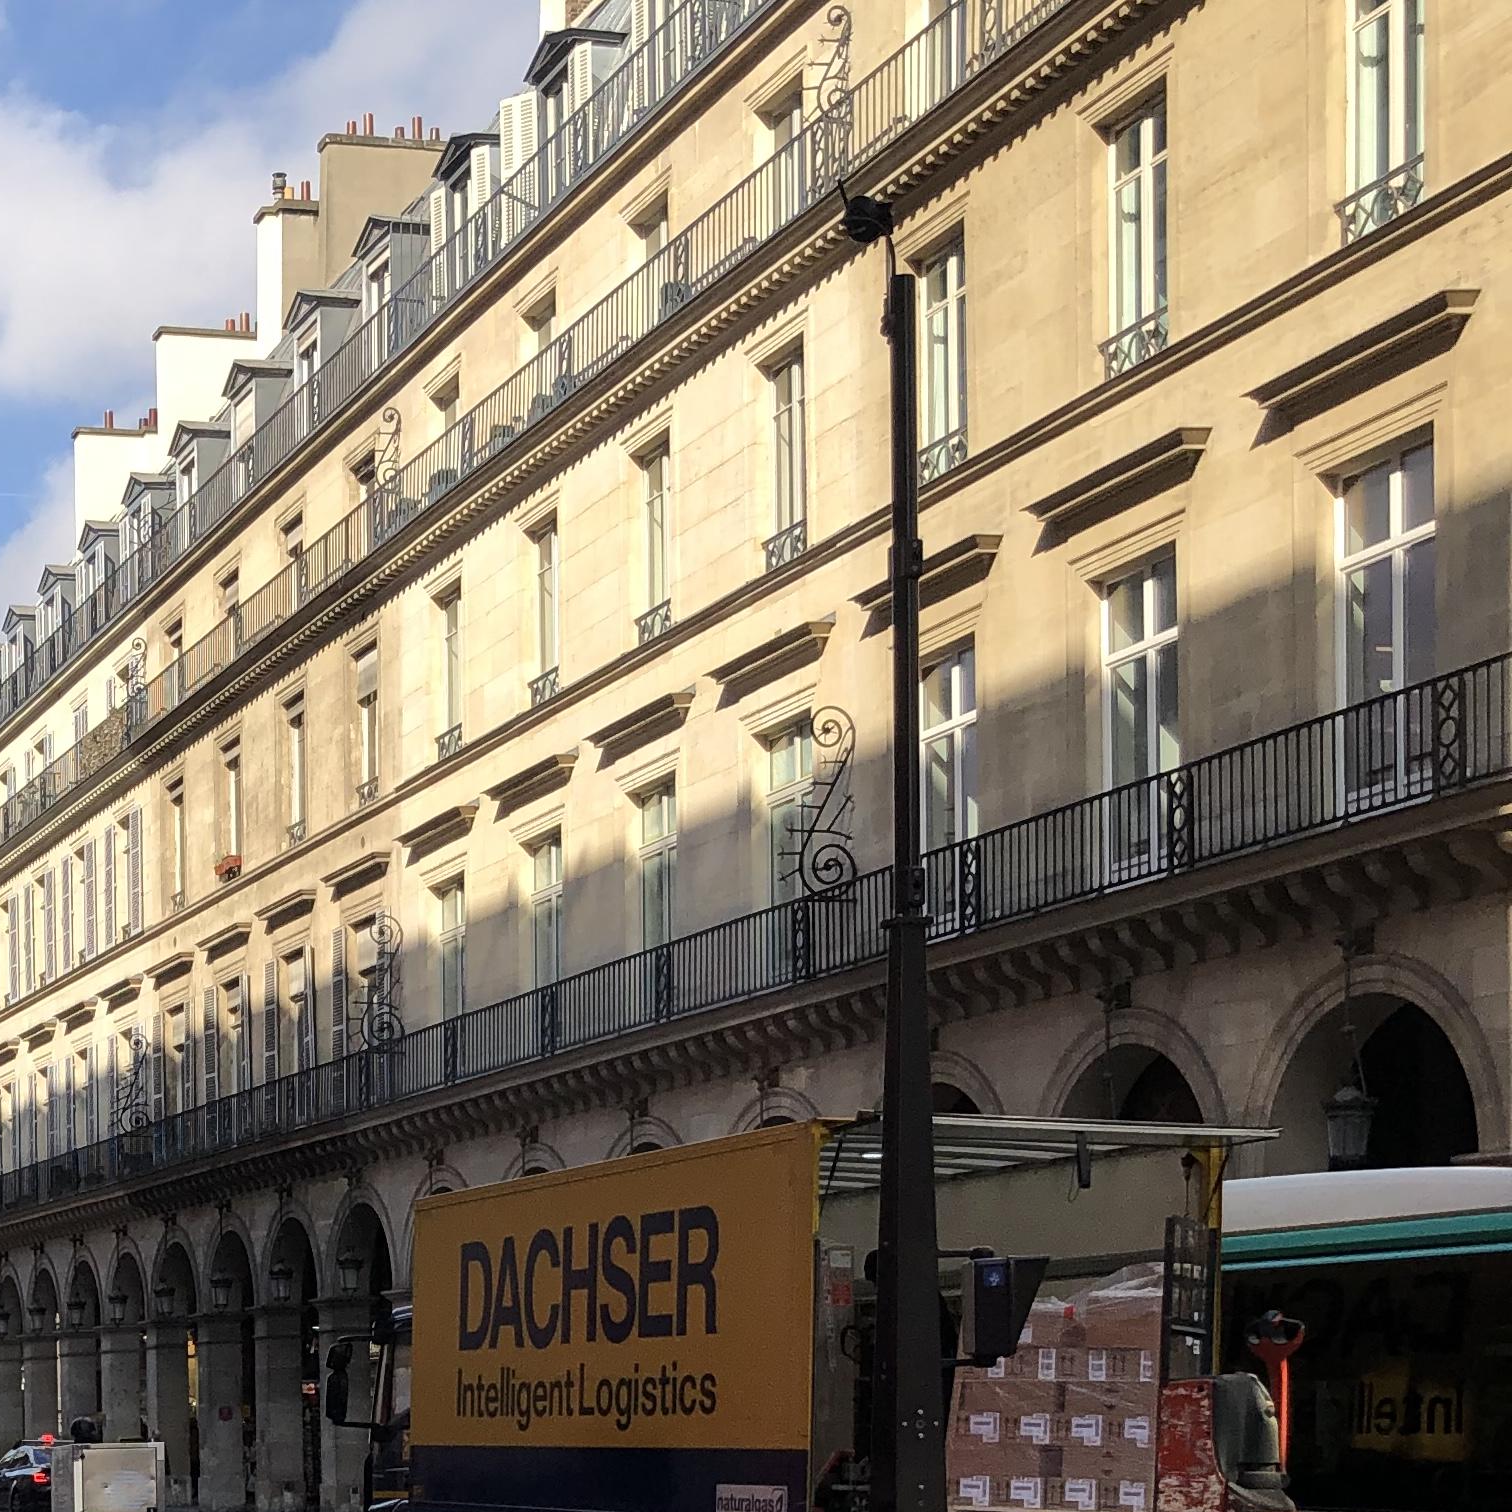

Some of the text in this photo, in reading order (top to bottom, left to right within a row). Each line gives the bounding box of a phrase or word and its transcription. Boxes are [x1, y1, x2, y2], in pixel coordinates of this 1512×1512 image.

[458, 1205, 719, 1351] DACHSER
[455, 1360, 718, 1431] Intelligent Logistics
